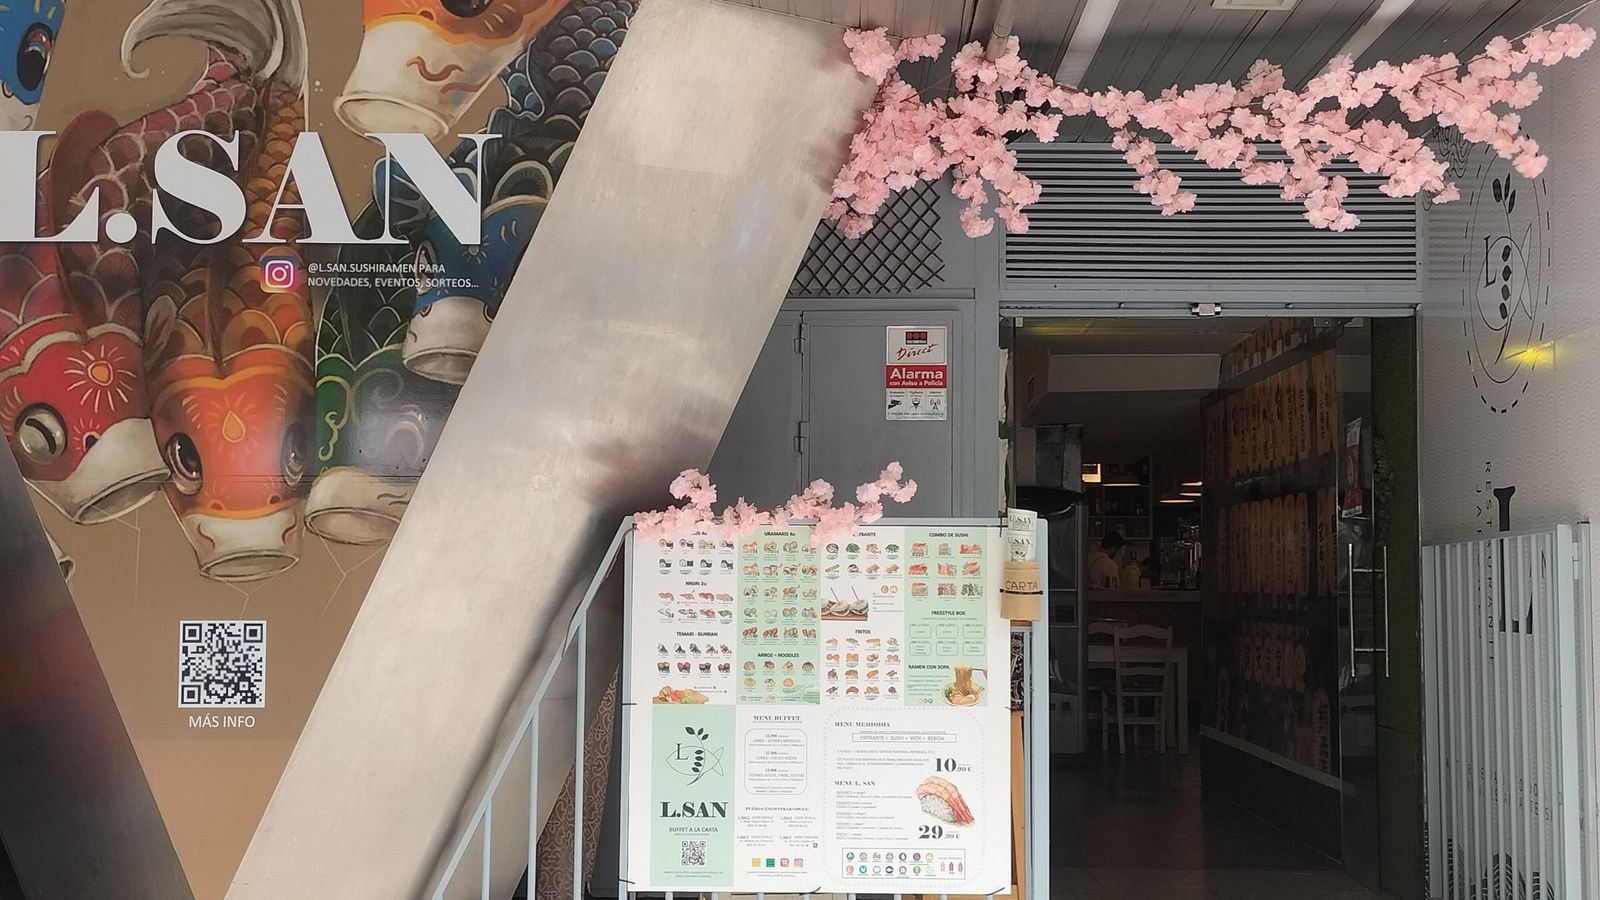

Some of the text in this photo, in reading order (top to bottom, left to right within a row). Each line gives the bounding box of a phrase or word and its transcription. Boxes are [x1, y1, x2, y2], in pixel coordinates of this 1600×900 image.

[0, 129, 502, 245] L.SAN
[308, 263, 446, 274] @L.SAN.SUSHIRAMEN PARA
[307, 277, 479, 289] NOVEDADES, EVENTOS, SORTEOS...
[896, 343, 938, 361] Direct
[890, 367, 943, 379] Alarma
[1005, 581, 1038, 591] CARTA
[660, 801, 728, 818] L.SAN
